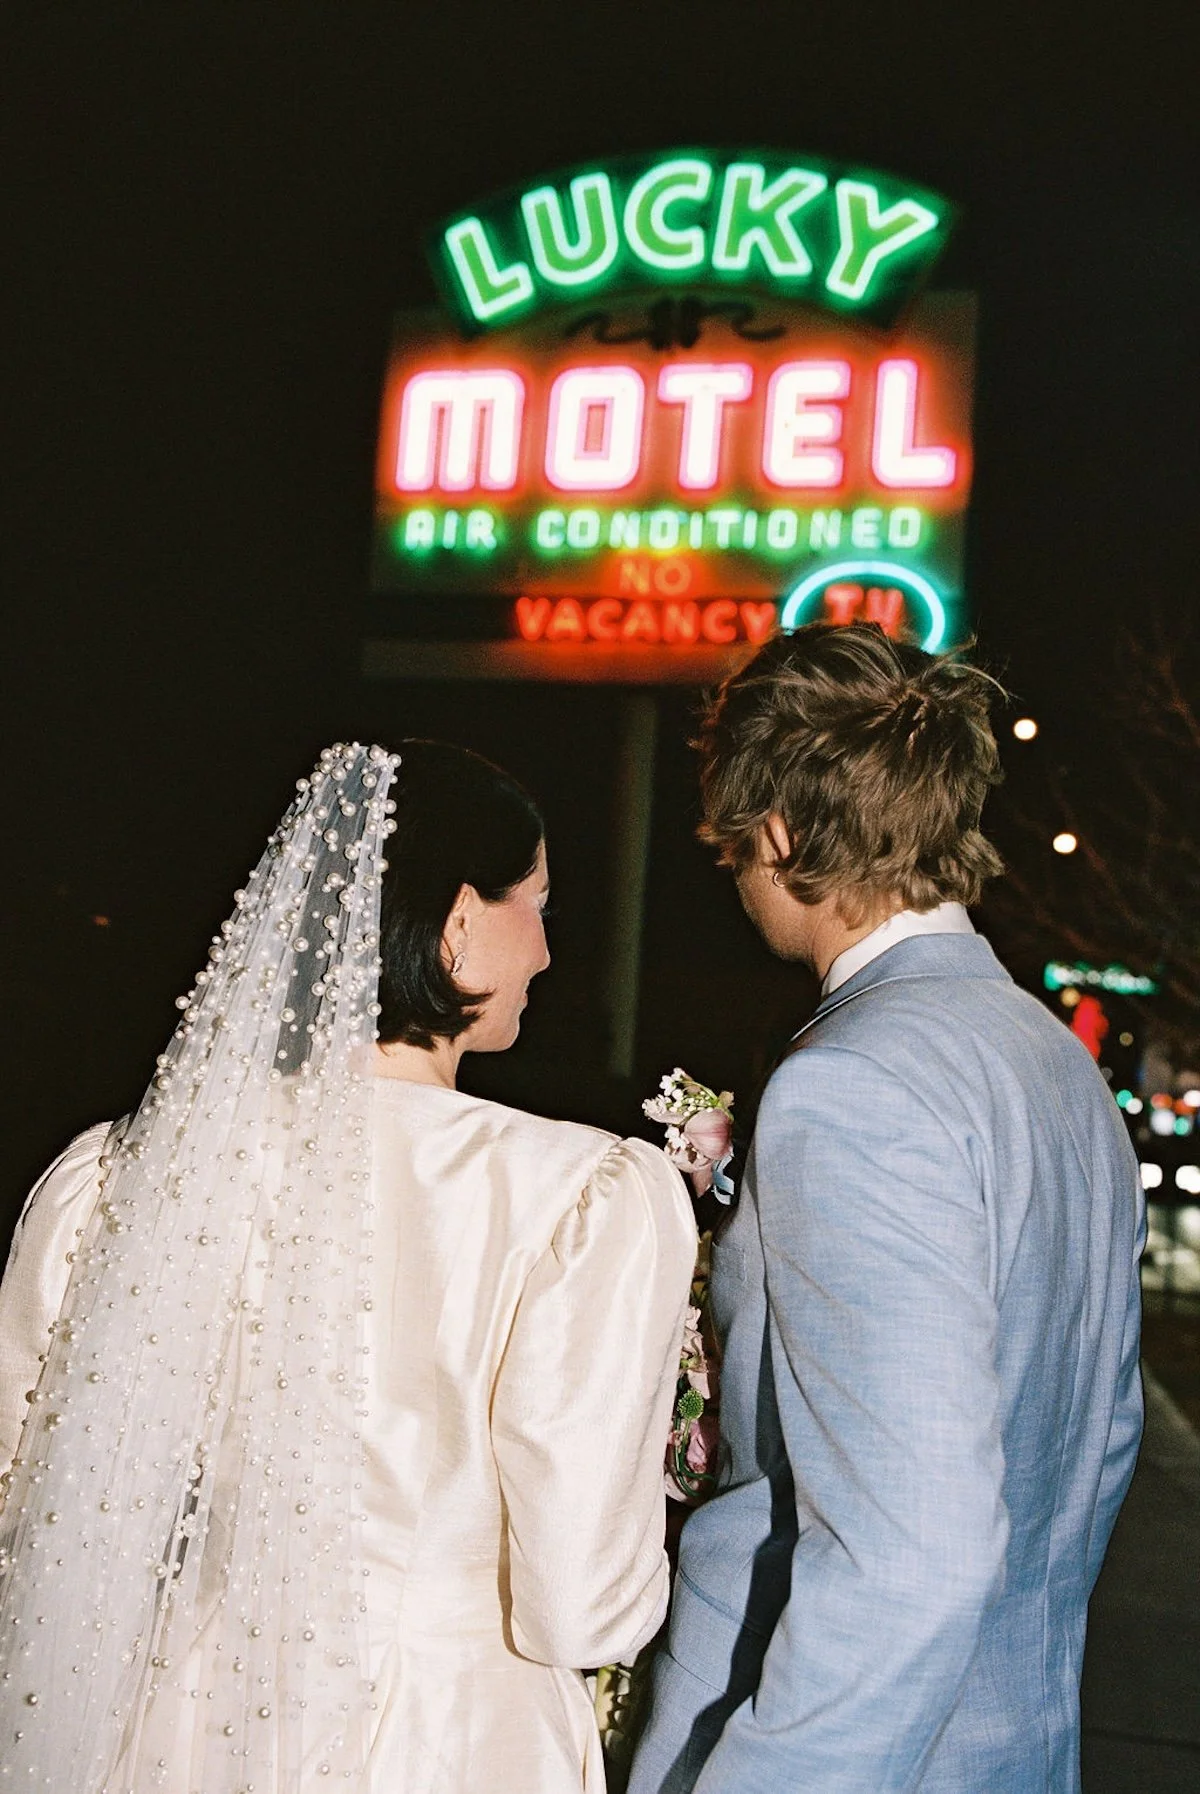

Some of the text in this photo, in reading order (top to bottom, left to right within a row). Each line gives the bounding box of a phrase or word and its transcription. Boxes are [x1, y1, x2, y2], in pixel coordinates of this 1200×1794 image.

[446, 160, 937, 320] LUCKY
[397, 361, 957, 491] MOTEL
[404, 507, 922, 549] AIR CONDITIONED
[620, 558, 692, 594] NO
[516, 596, 776, 642] VACANCY
[824, 584, 904, 640] TV
